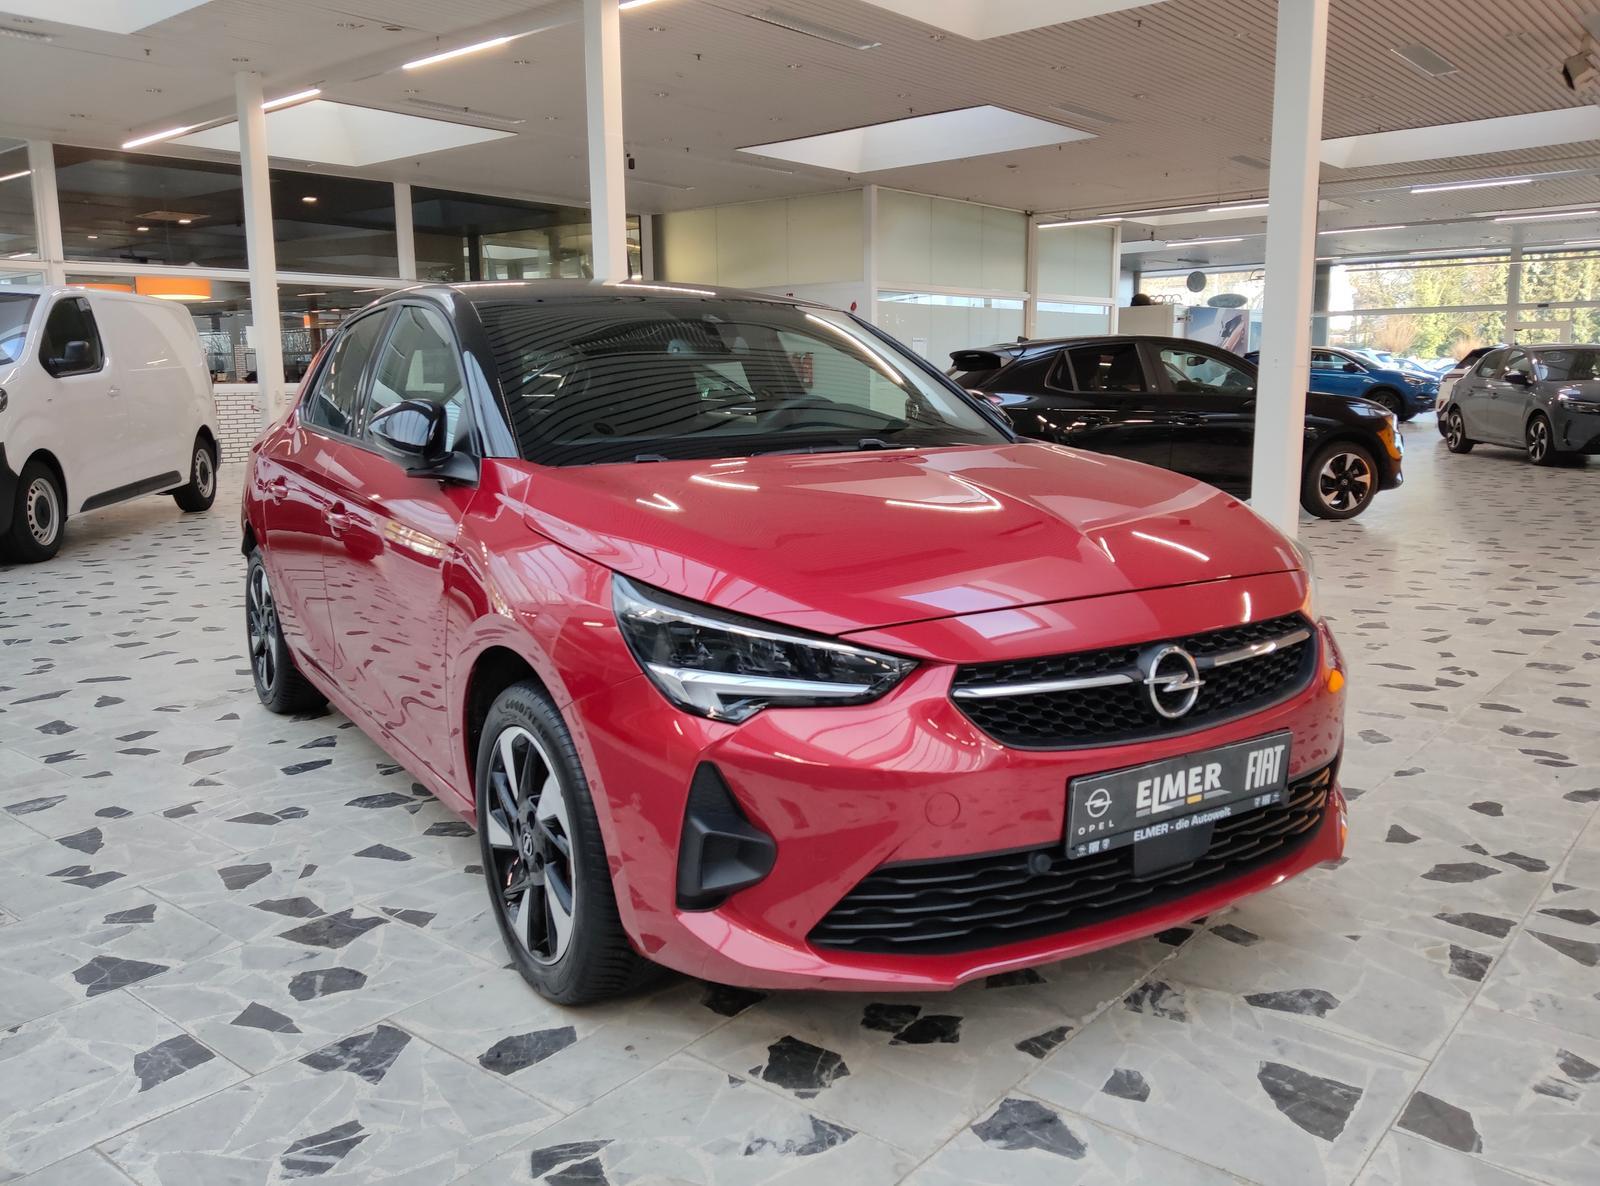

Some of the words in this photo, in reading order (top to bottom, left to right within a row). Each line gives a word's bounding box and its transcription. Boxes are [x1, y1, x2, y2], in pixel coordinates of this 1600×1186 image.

[1245, 745, 1285, 790] FIAT
[1136, 763, 1222, 814] ELMER
[1078, 820, 1114, 835] OPEL
[1133, 823, 1169, 842] ELMER
[1175, 818, 1190, 830] die
[1191, 807, 1231, 826] Autowelt
